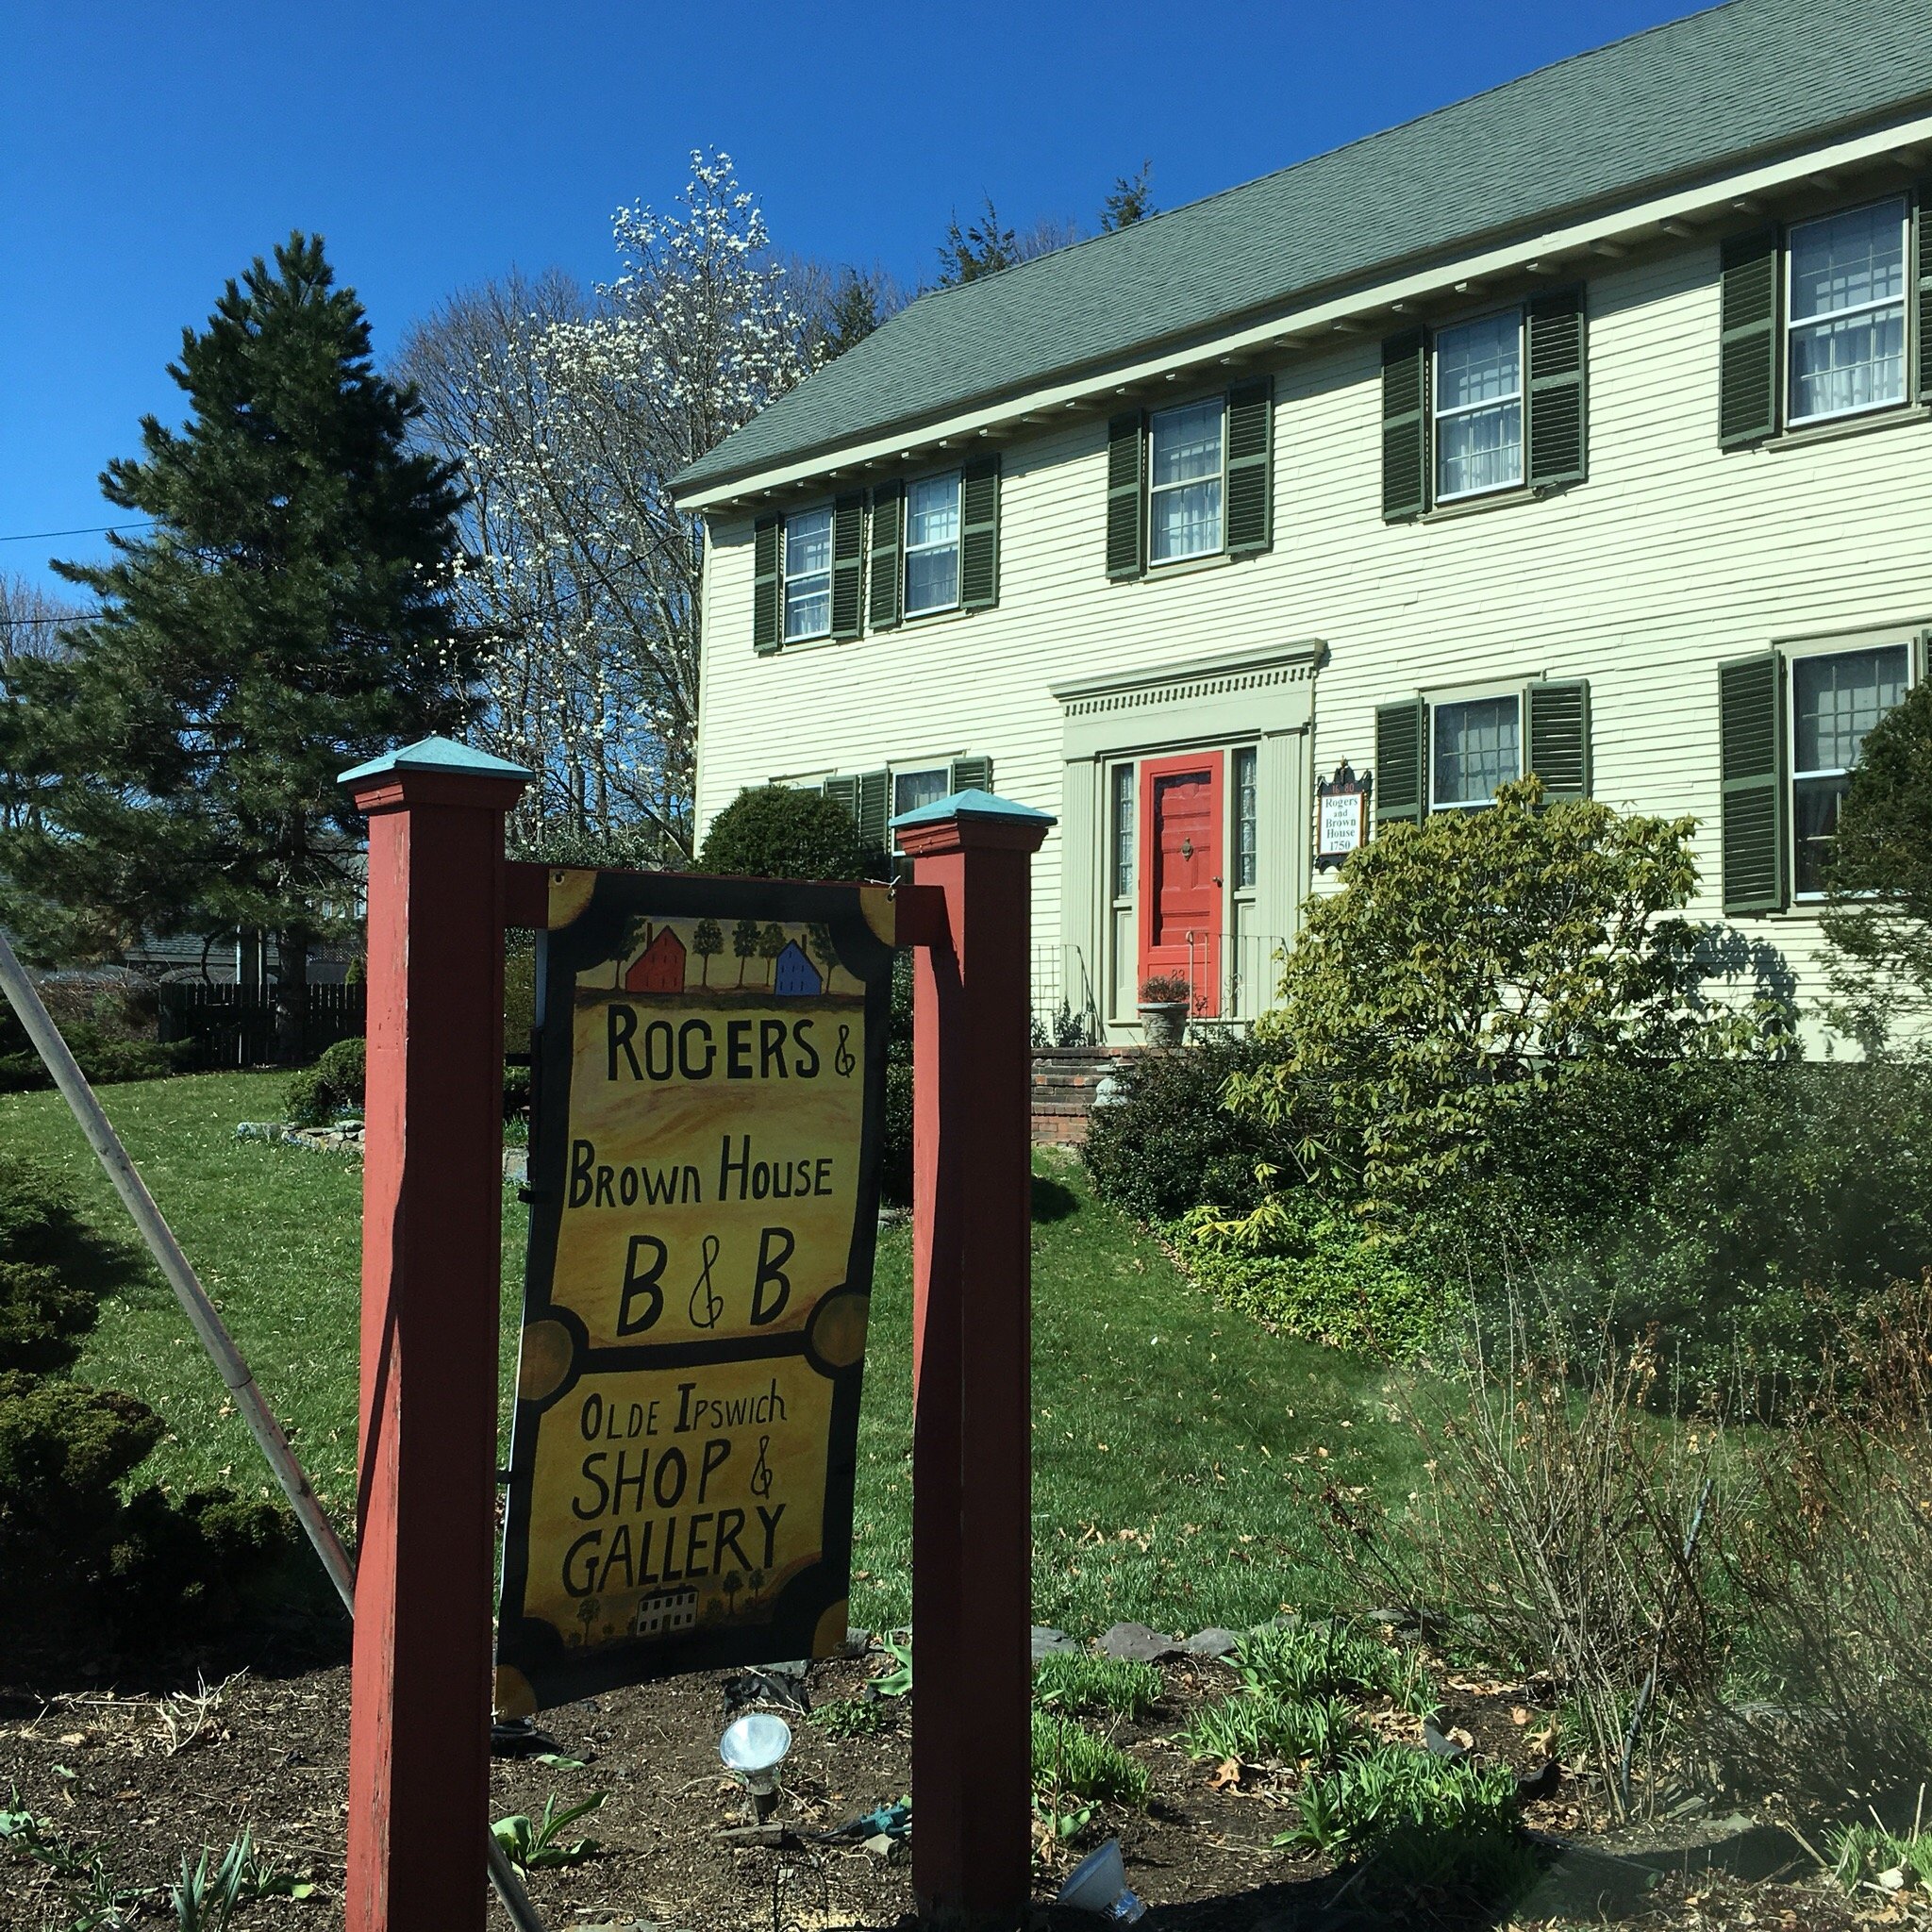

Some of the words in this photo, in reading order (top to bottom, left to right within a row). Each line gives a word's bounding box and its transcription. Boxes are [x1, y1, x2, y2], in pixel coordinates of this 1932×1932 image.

[1325, 797, 1357, 808] Rogers
[1326, 818, 1356, 828] Brown
[1334, 809, 1347, 818] and
[1326, 828, 1355, 839] House
[1330, 841, 1350, 851] 1750
[607, 1004, 821, 1081] ROGERS
[834, 1024, 857, 1078] &
[718, 1134, 834, 1202] HOUSE
[616, 1235, 668, 1337] B
[689, 1235, 724, 1329] &
[750, 1227, 795, 1326] B
[580, 1392, 660, 1441] OLDE
[572, 1438, 732, 1521] SHOP
[750, 1435, 773, 1500] &
[561, 1503, 787, 1598] GALLERY
